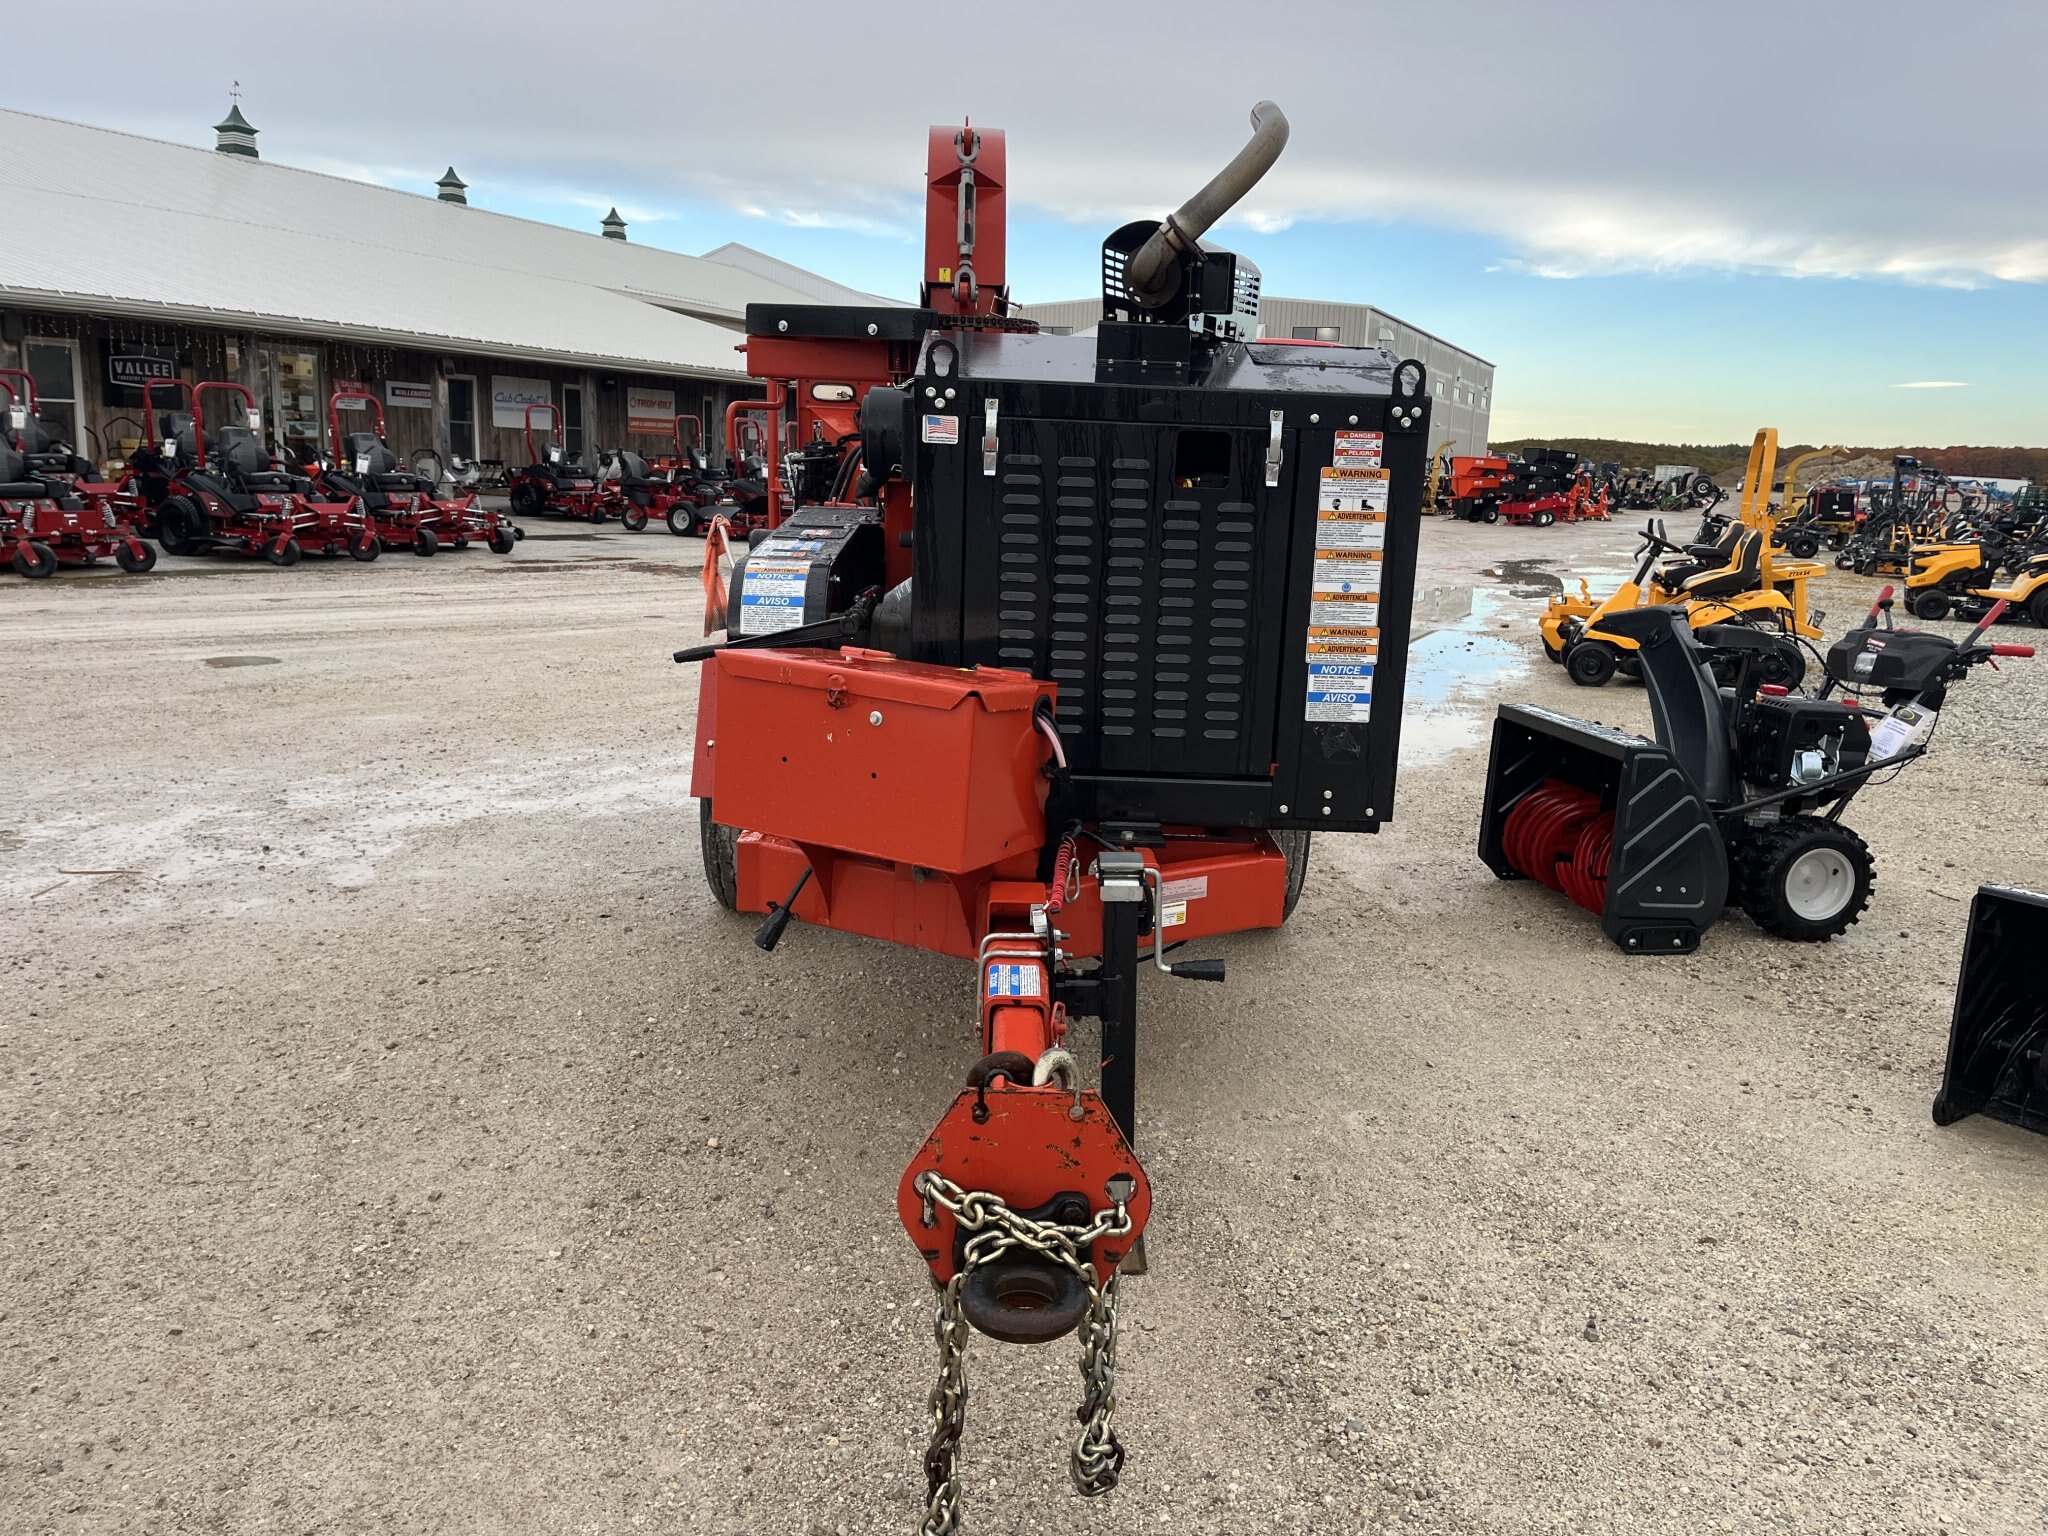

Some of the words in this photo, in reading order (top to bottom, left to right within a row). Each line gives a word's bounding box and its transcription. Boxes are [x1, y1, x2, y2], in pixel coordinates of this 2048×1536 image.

[114, 361, 169, 376] VALLEE
[495, 392, 512, 403] Cub
[637, 399, 672, 410] TROY-BILT
[1340, 470, 1382, 478] WARNING
[756, 597, 790, 605] AVISO
[1320, 665, 1362, 675] NOTICE
[1322, 693, 1356, 703] AVISO
